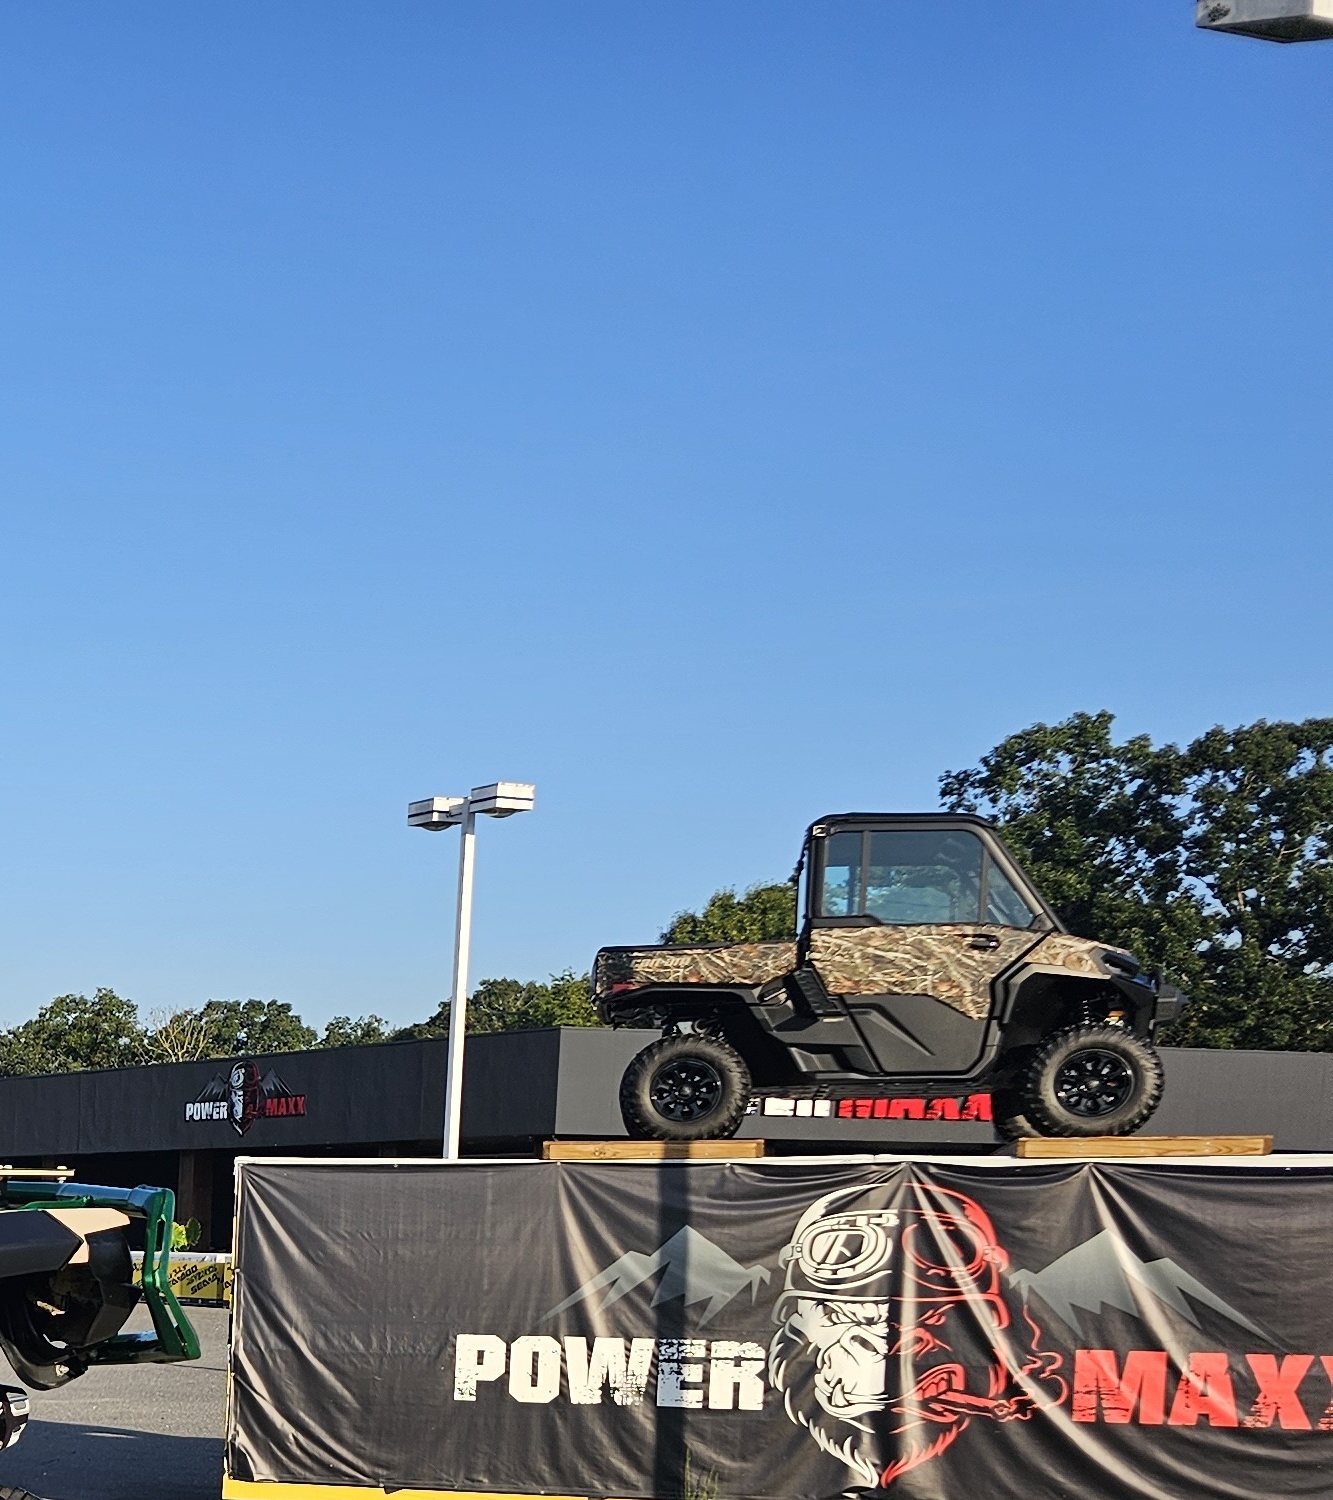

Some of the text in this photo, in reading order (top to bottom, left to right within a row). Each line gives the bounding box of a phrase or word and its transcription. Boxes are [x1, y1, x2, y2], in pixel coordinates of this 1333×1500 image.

[185, 1096, 306, 1121] POWER MAXX
[453, 1333, 1333, 1430] POWER MAX
